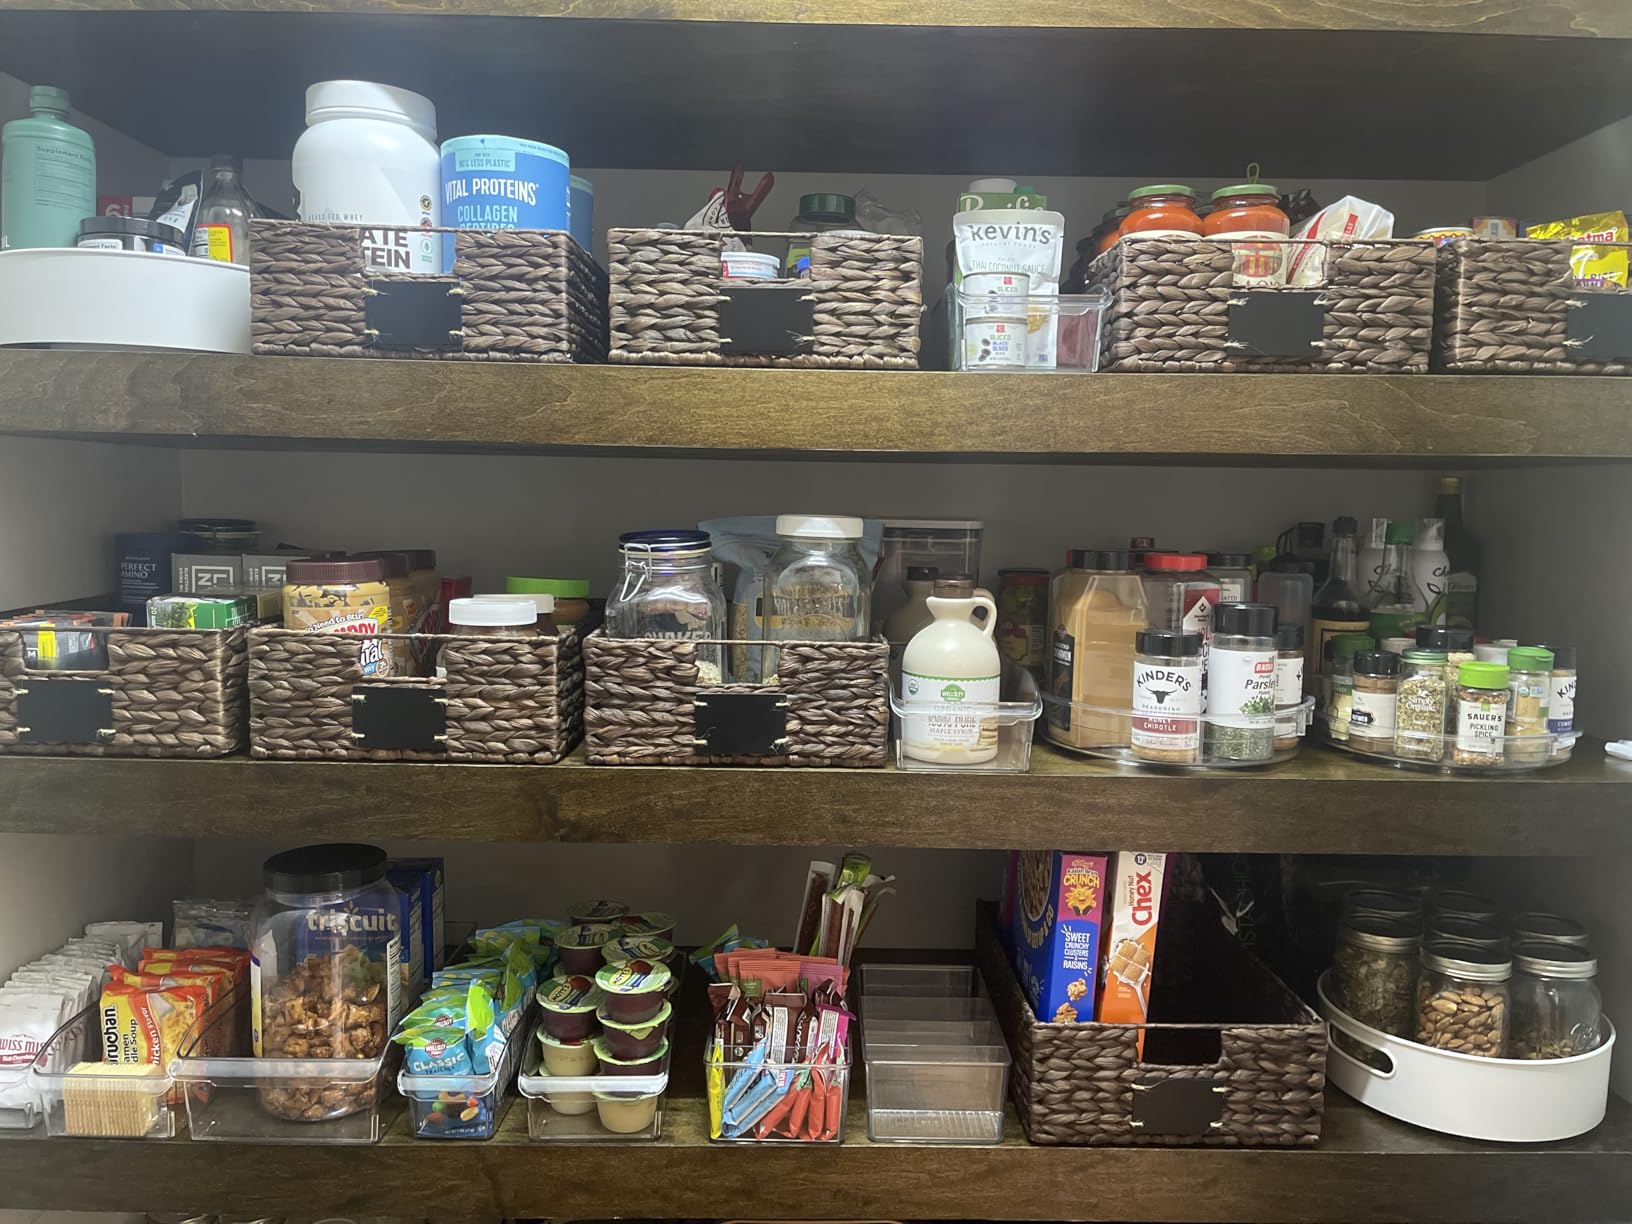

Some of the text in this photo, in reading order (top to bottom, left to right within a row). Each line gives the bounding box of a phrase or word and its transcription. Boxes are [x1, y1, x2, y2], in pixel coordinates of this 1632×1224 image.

[470, 159, 485, 168] LESS
[486, 158, 511, 169] PLASTIC
[445, 178, 538, 207] VITAL PROTEINS
[457, 205, 518, 223] COLLAGEN
[120, 561, 157, 574] PERFECT
[120, 570, 149, 579] AMINO
[313, 616, 336, 632] Need
[335, 613, 346, 624] to
[1136, 670, 1193, 693] KINDER'S
[1141, 703, 1181, 712] SEASONING
[1467, 713, 1503, 722] SAUER'S
[1143, 721, 1177, 731] CHIPOTLE
[1469, 723, 1500, 732] PICKLING
[1063, 875, 1100, 889] CRUNCH
[1127, 874, 1136, 907] Honey Nut
[1131, 868, 1152, 926] Chex
[305, 908, 397, 936] triscuit
[1065, 932, 1091, 943] SWEET
[1064, 942, 1090, 950] CRUNCHY
[1062, 960, 1088, 970] RAISINS
[141, 1007, 154, 1029] Flavor
[130, 1019, 139, 1046] Soup
[413, 1052, 466, 1072] CLASSIC
